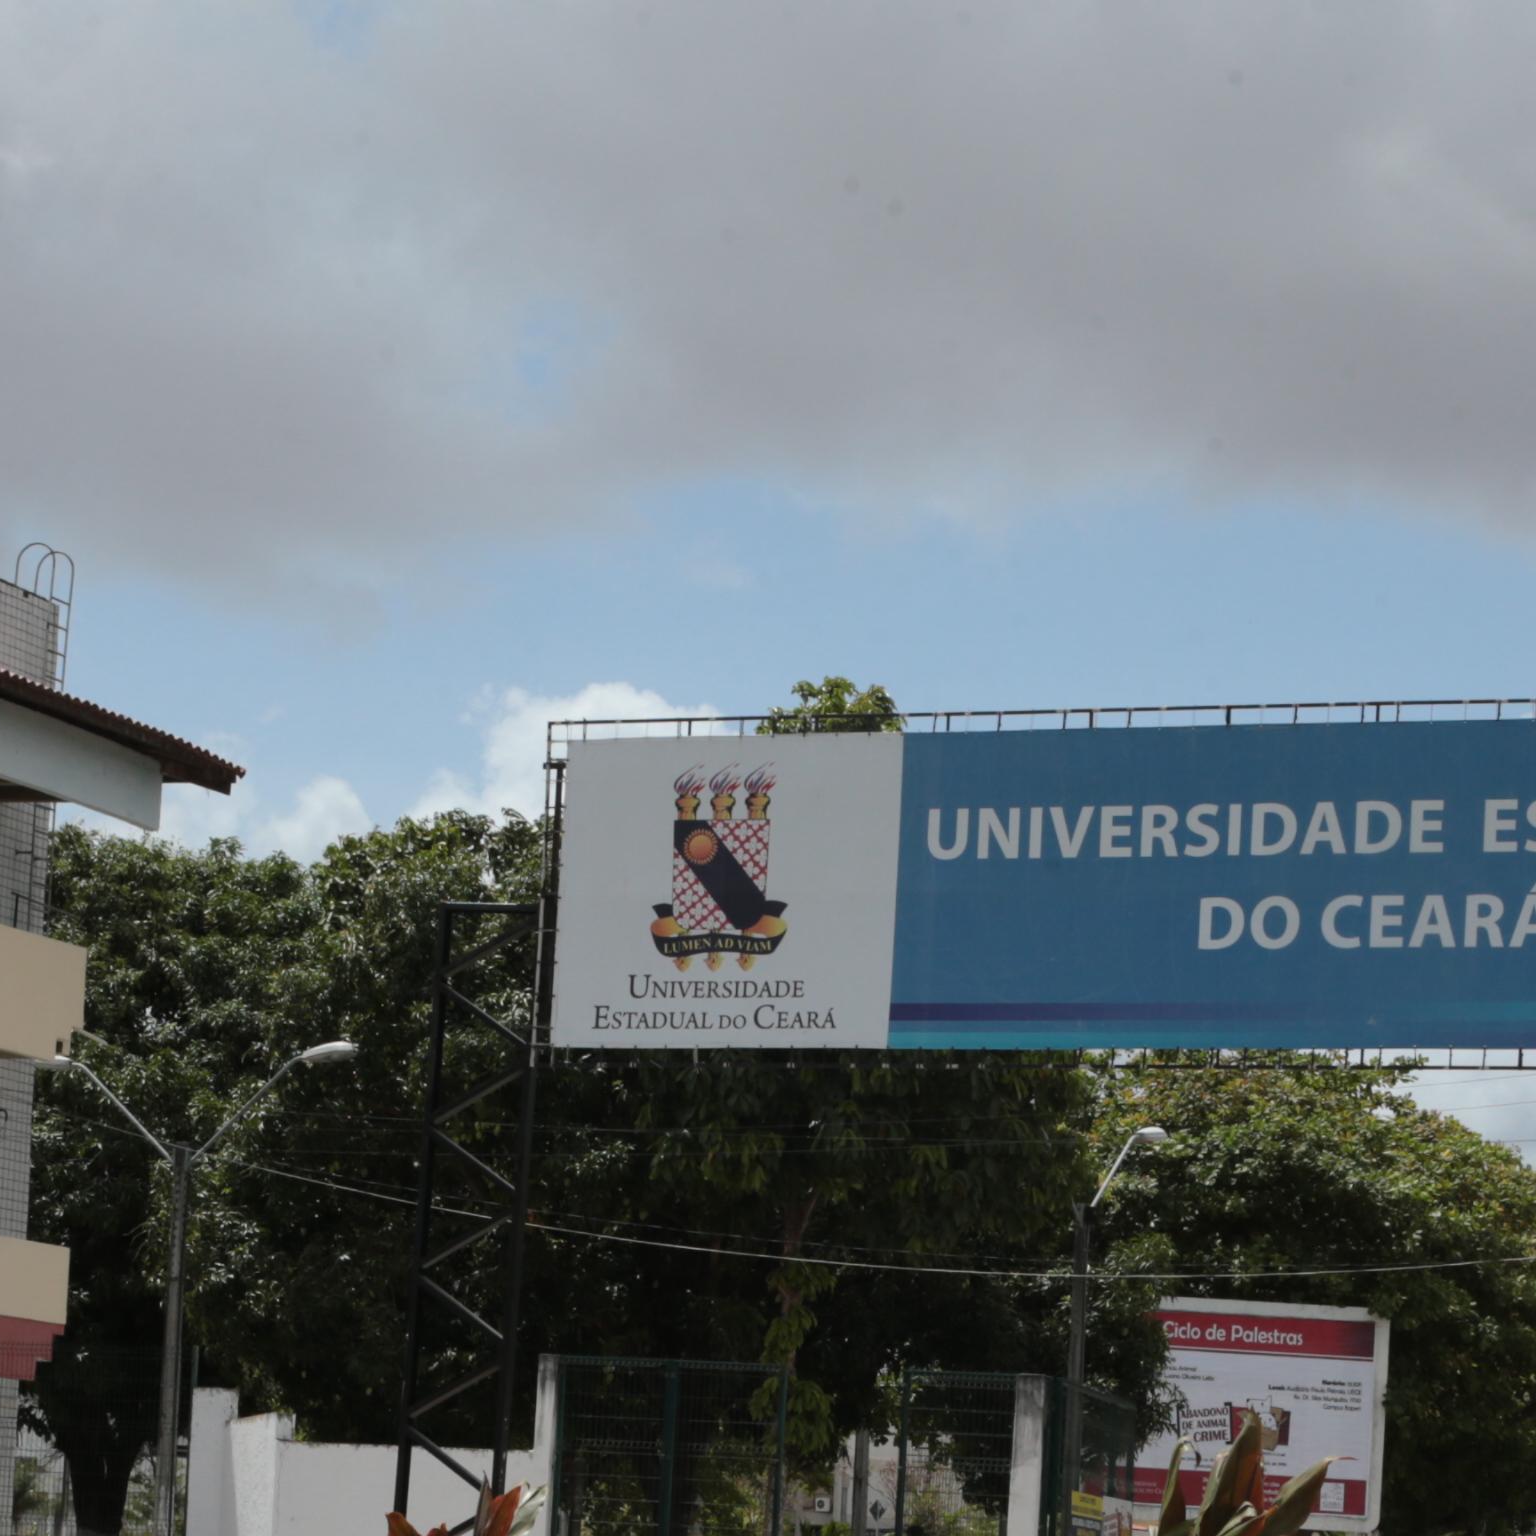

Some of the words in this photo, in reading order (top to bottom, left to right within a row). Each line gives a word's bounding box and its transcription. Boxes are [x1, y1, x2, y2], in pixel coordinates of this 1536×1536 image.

[927, 800, 1445, 860] UNIVERSIDADE
[1198, 895, 1300, 951] DO
[663, 938, 711, 954] LUMEN
[716, 938, 734, 949] AD
[738, 939, 773, 952] VIAM
[627, 974, 804, 999] UNIVERSIDADE
[592, 1004, 714, 1030] ESTADUAL
[718, 1014, 747, 1030] DO
[753, 1004, 837, 1030] CEARÁ
[1163, 1320, 1201, 1340] Ciclo
[1205, 1324, 1226, 1341] de
[1231, 1325, 1304, 1346] Palestras
[1181, 1407, 1229, 1418] ABANDONO
[1182, 1420, 1193, 1430] DE
[1197, 1419, 1228, 1428] ANIMAL
[1193, 1430, 1229, 1443] CRIME
